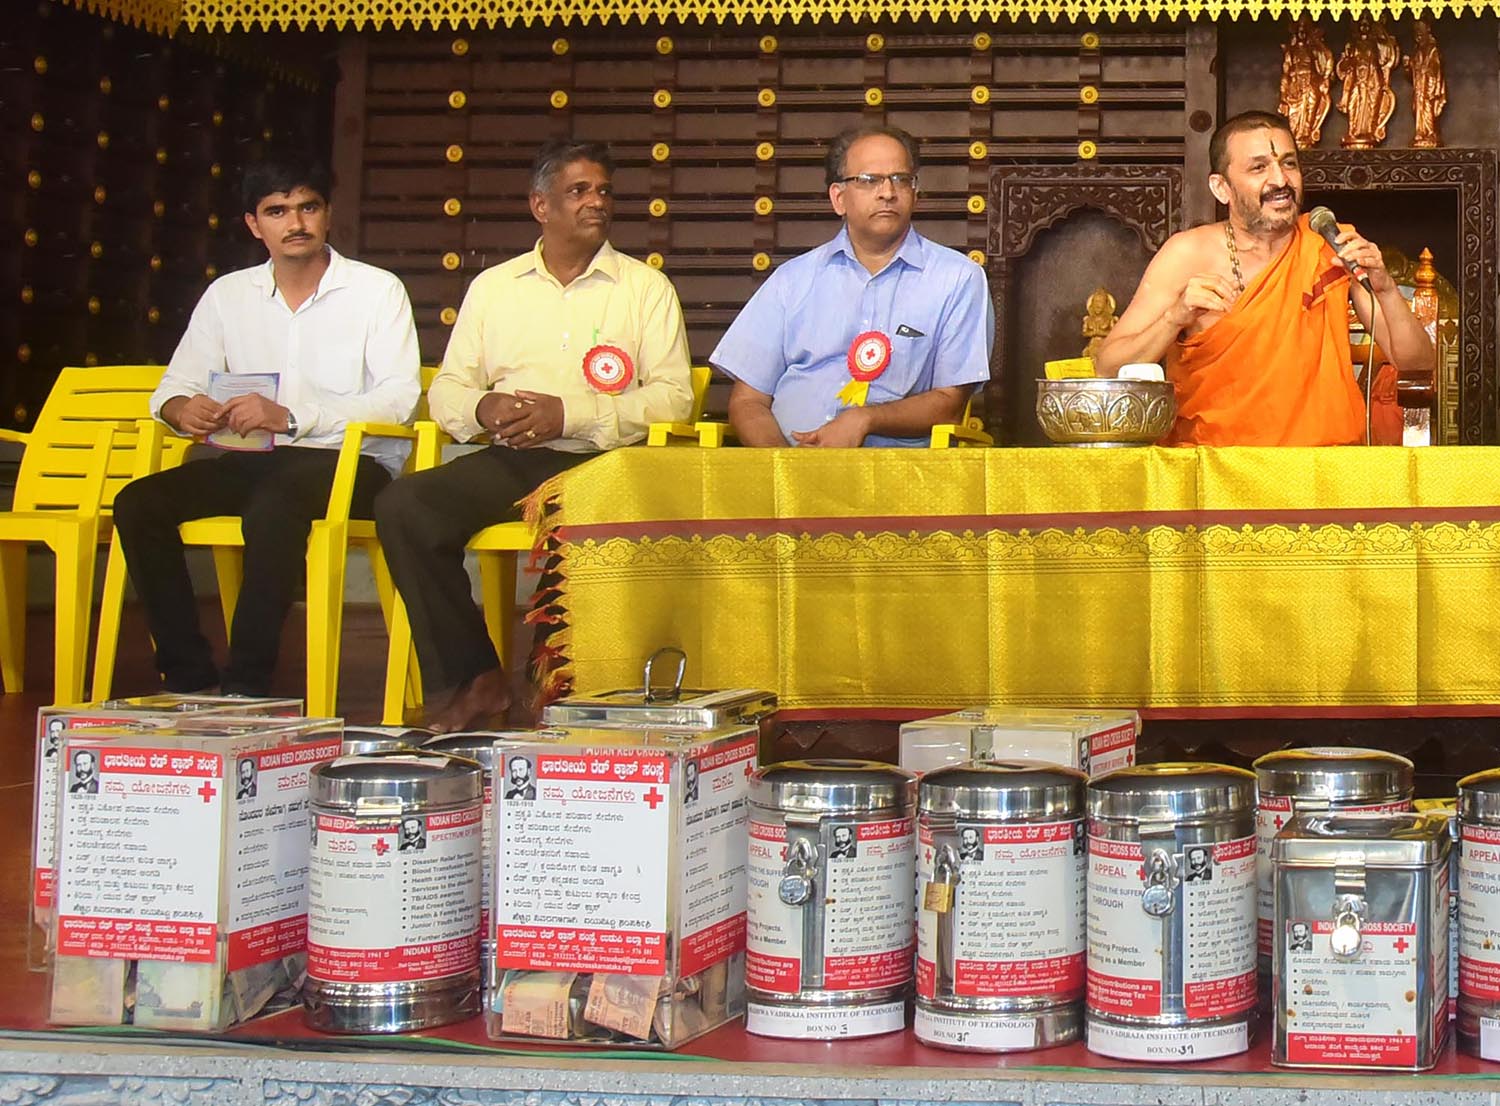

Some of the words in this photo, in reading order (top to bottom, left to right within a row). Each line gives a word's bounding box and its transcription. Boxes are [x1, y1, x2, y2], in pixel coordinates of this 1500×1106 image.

[260, 754, 280, 767] INDIAN
[281, 752, 294, 764] RED
[295, 749, 315, 761] CROSS
[315, 745, 340, 759] SOCIETY
[1095, 863, 1127, 878] APPEAL
[1384, 923, 1412, 932] SOCIETY
[1112, 944, 1140, 954] Projects.
[1118, 956, 1145, 967] Member
[1190, 1031, 1201, 1039] OF
